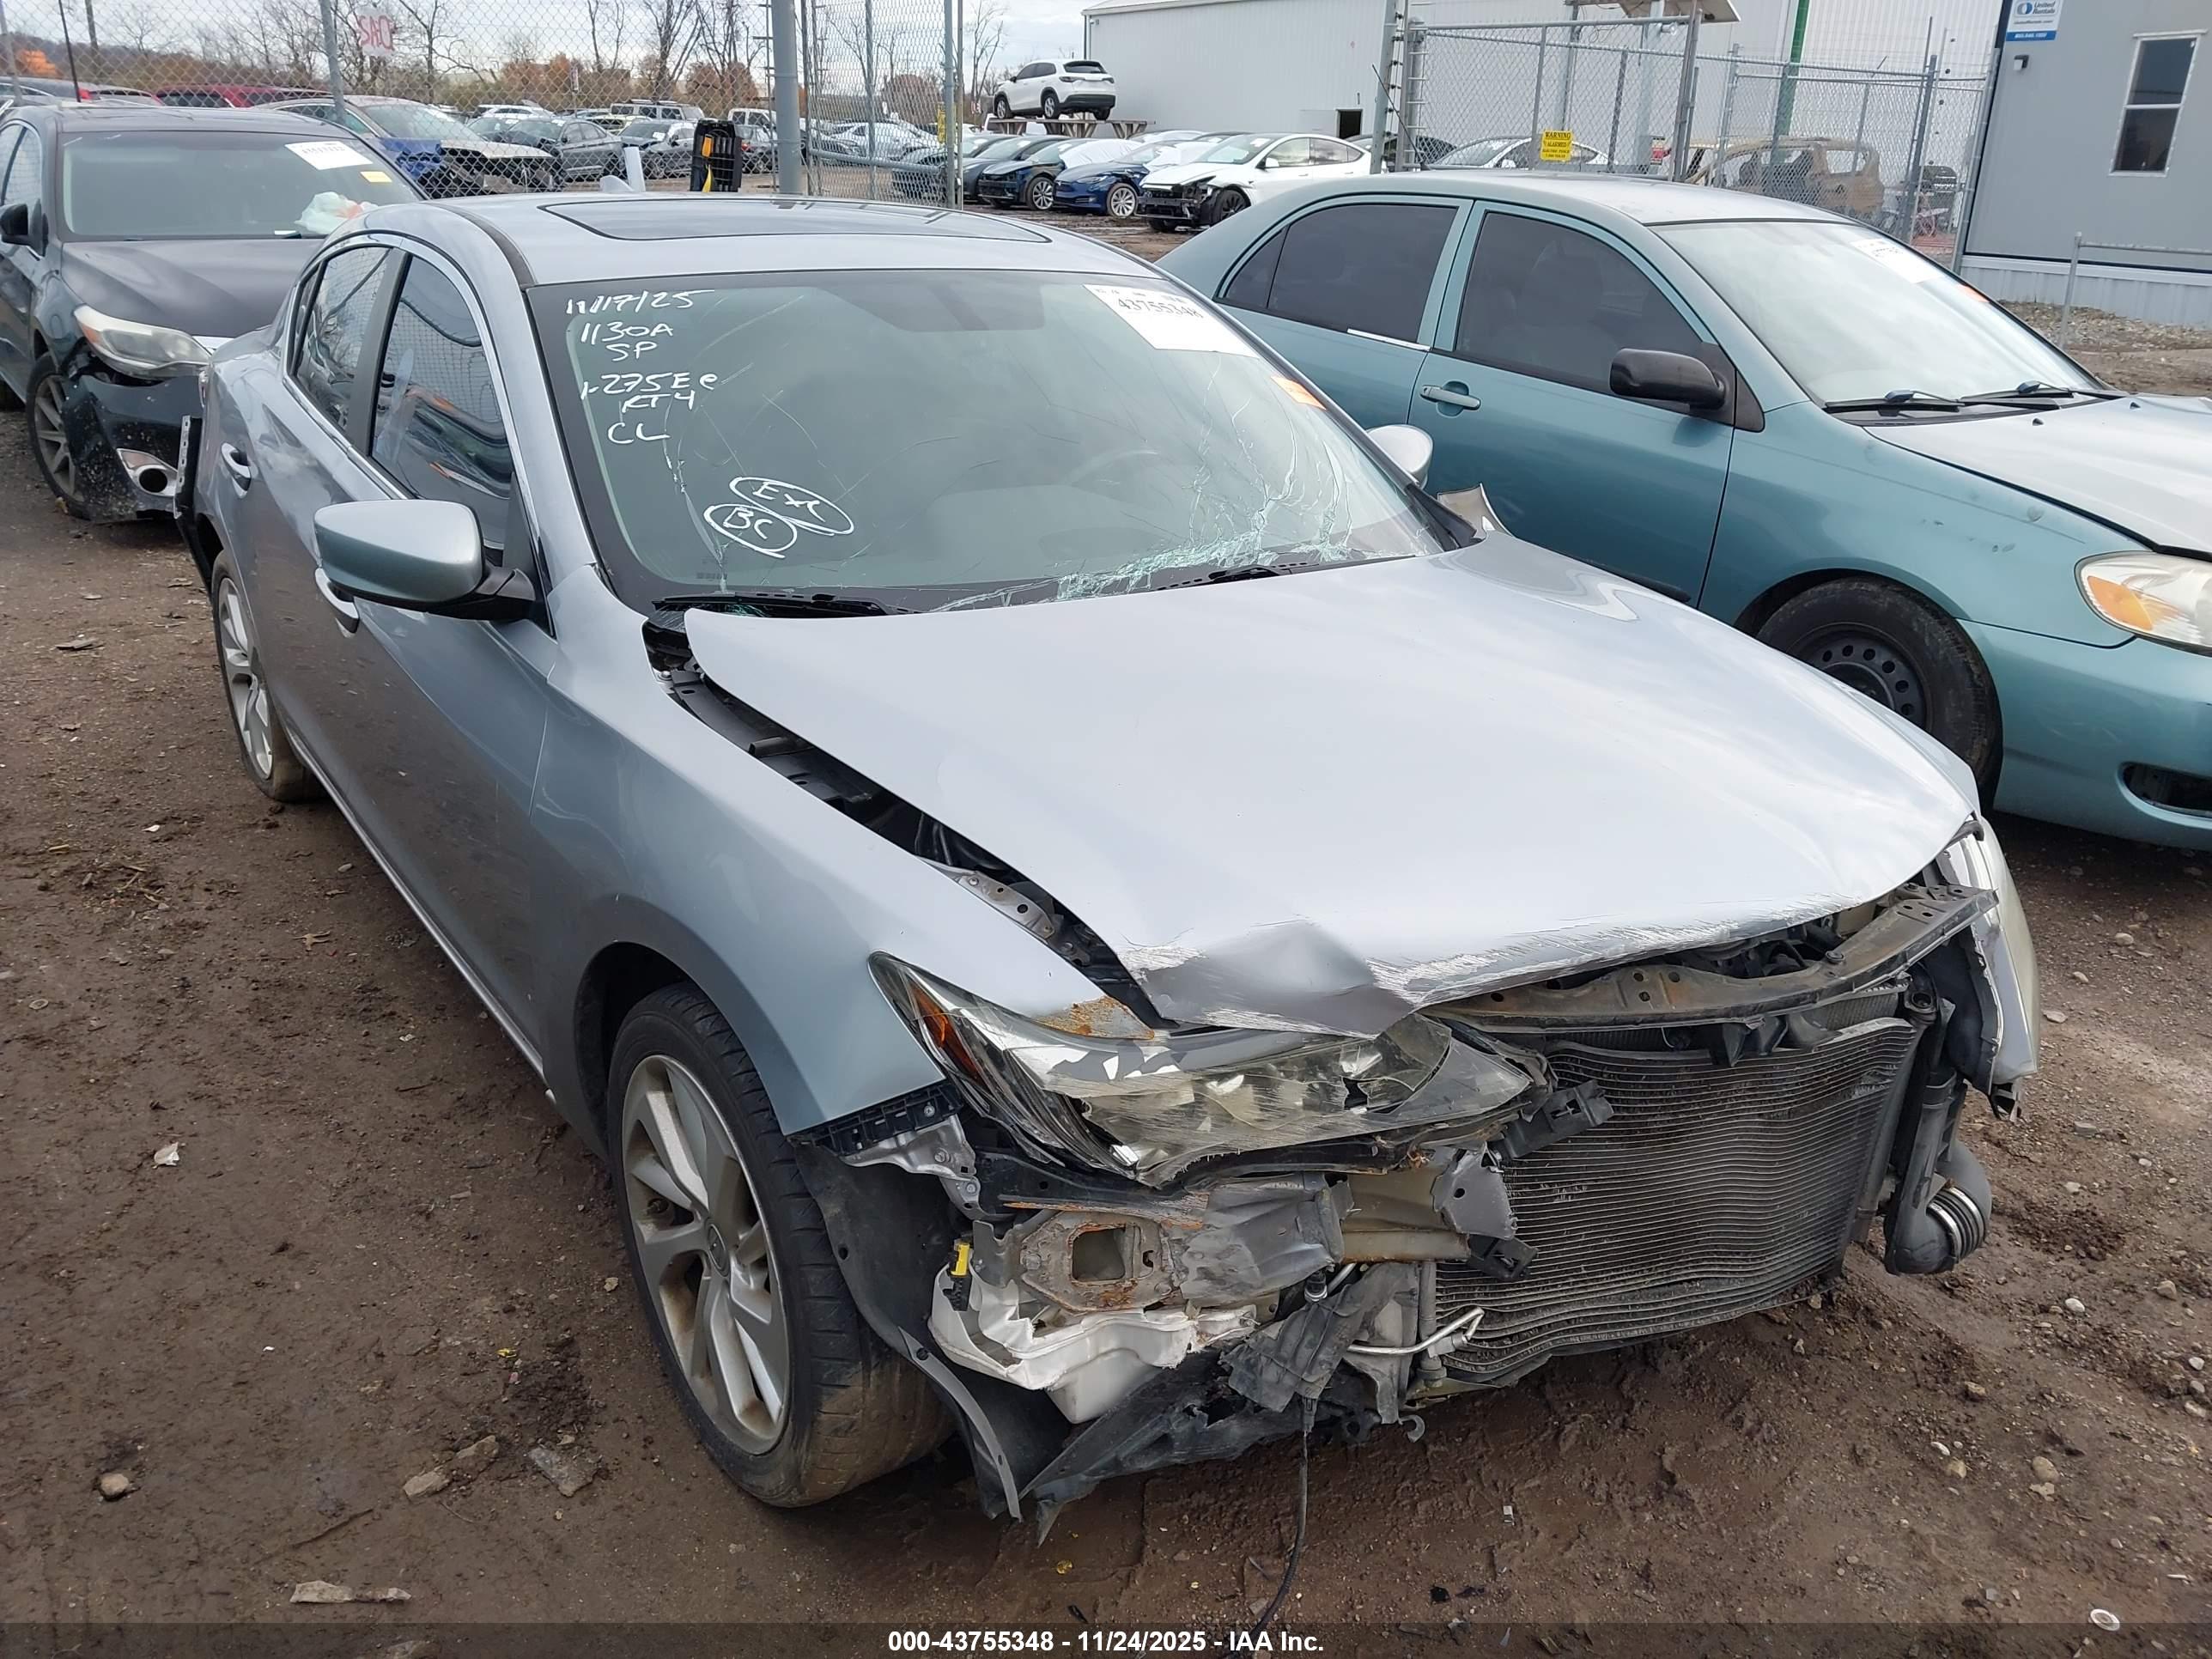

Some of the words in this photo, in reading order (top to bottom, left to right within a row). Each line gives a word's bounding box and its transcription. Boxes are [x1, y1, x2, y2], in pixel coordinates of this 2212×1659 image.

[580, 320, 673, 344] 1130A
[605, 341, 658, 362] SP
[608, 422, 671, 445] CL
[723, 507, 773, 540] BC
